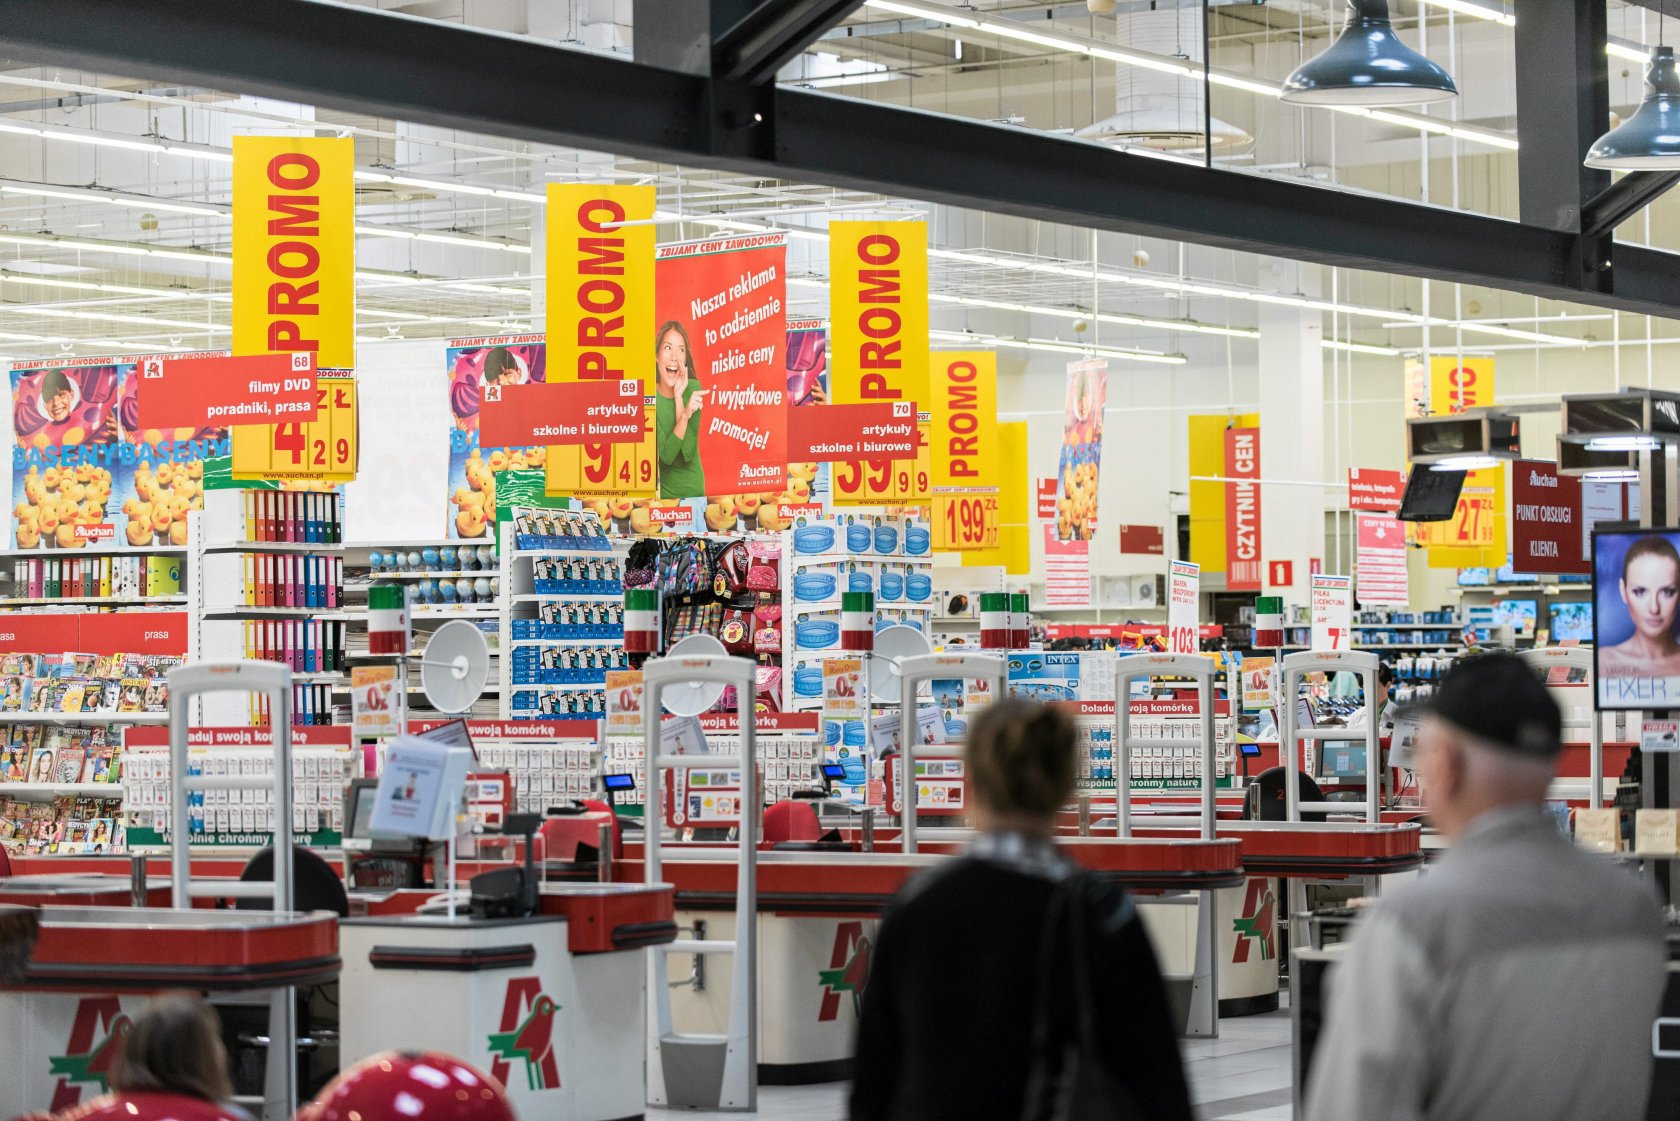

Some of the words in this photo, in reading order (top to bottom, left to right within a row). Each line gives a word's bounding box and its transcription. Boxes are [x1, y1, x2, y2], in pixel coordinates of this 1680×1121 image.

[267, 152, 321, 352] PROMO
[660, 244, 698, 258] ZBIJAMY
[700, 240, 723, 252] CENY
[725, 235, 784, 250] ZAWODOWO!
[577, 199, 626, 380] PROMO
[690, 290, 726, 320] Nasza
[729, 265, 776, 299] reklama
[705, 326, 717, 346] to
[719, 298, 781, 339] codziennie
[857, 234, 902, 399] PROMO
[450, 338, 486, 347] ZBIJAMY
[488, 336, 510, 345] CENY
[512, 335, 546, 344] ZAWOD
[12, 360, 44, 370] ZBIJAMY
[46, 359, 65, 368] CENY
[66, 356, 114, 367] ZAWODOWO!
[294, 356, 308, 368] 68
[711, 350, 745, 375] niskie
[748, 344, 775, 368] ceny
[249, 381, 280, 396] filmy
[284, 379, 310, 391] DVD
[622, 383, 636, 392] 69
[317, 389, 351, 409] ZŁ
[711, 386, 716, 404] i
[718, 386, 782, 410] wyjątkowe
[207, 402, 273, 418] poradniki,
[275, 401, 311, 416] prasa
[587, 404, 638, 417] artykuły
[896, 405, 908, 414] 70
[947, 361, 978, 477] PROMO
[533, 424, 578, 437] szkolne
[581, 424, 585, 434] i
[588, 424, 638, 434] biurowe
[709, 416, 770, 449] promocje!
[862, 424, 912, 436] artykuły
[274, 421, 305, 465] 4
[313, 438, 349, 465] 29
[810, 442, 854, 454] szkolne
[856, 442, 860, 452] i
[864, 442, 912, 452] biurowe
[14, 443, 119, 469] BASENY
[121, 439, 229, 465] BASENY
[1235, 434, 1254, 473] CEN
[584, 444, 612, 483] 9
[619, 459, 652, 483] 49
[740, 464, 780, 478] Auchan
[263, 472, 324, 480] www.auchan.pl
[738, 478, 782, 486] www.auchan.pl
[898, 471, 928, 492] 99
[1530, 470, 1558, 488] Auchan
[650, 509, 692, 520] Auchan
[779, 504, 822, 516] Auchan
[1516, 504, 1539, 522] PUNKT
[1540, 505, 1572, 524] OBSŁUGI
[947, 498, 984, 544] 199
[985, 498, 998, 510] ZŁ
[1236, 478, 1256, 560] CZYTNIK
[1458, 499, 1480, 540] 27
[75, 526, 114, 537] Auchan
[1530, 540, 1558, 558] KLIENTA
[400, 614, 404, 624] 6
[0, 632, 15, 641] asa
[144, 630, 168, 642] prasa
[1172, 626, 1193, 654] 103
[1328, 628, 1340, 650] 7
[1047, 656, 1078, 664] INTEX
[1606, 676, 1666, 699] FIXER
[1081, 704, 1116, 714] Doładuj
[1128, 705, 1148, 714] woją
[1151, 704, 1194, 714] komórkę
[702, 718, 726, 728] woją
[730, 716, 778, 728] koórkę
[188, 730, 214, 744] aduj
[216, 731, 251, 744] swoją
[254, 730, 308, 744] kokę
[469, 725, 501, 738] swoją
[504, 724, 555, 737] komórkę
[1128, 778, 1165, 789] hrońmy
[1166, 778, 1199, 788] naturę
[162, 832, 215, 844] Wólnie
[218, 832, 270, 846] chrońmy
